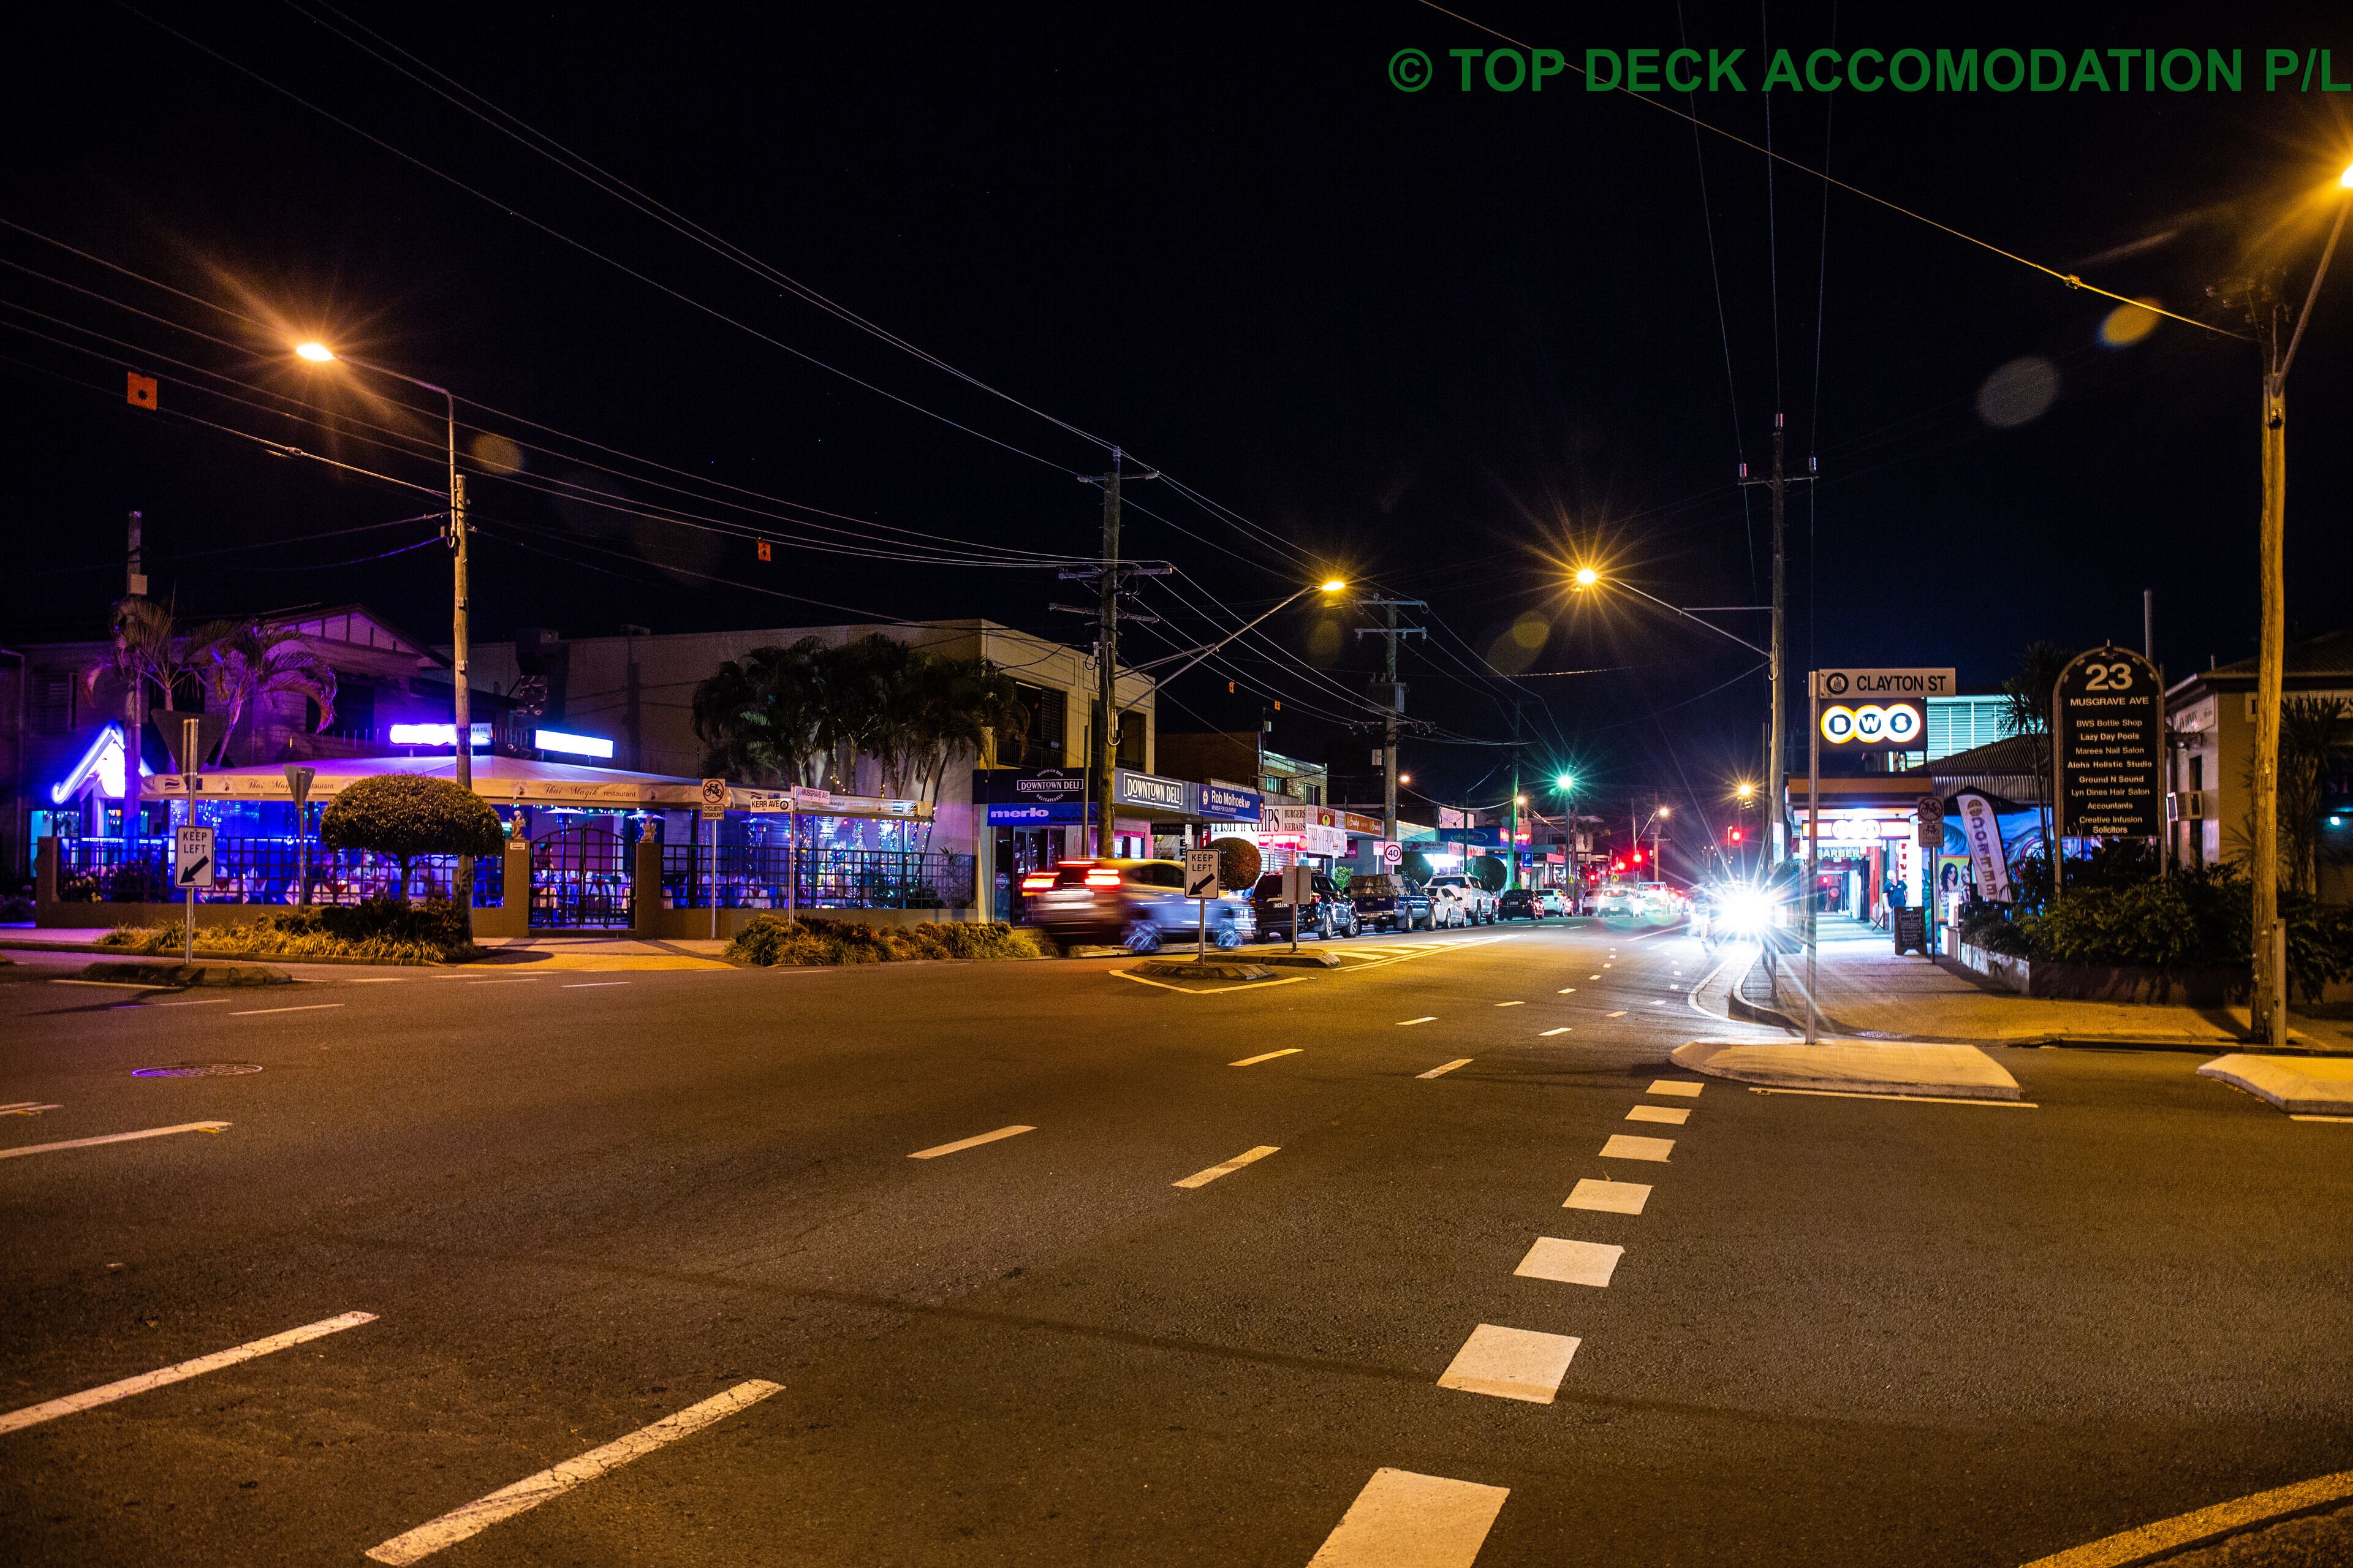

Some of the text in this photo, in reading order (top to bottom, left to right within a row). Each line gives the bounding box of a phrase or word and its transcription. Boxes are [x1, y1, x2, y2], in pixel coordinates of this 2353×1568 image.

[2085, 663, 2133, 691] 23
[1857, 675, 1946, 692] CLAYTON ST
[2070, 695, 2150, 706] MUSGRAVE AVE
[1833, 715, 1908, 733] BWS
[2097, 718, 2120, 727] Bottle
[2122, 718, 2143, 728] Shop
[2080, 732, 2140, 742] Lazy Day Pools
[1036, 769, 1056, 778] SANDWICH
[2078, 775, 2109, 784] Ground
[2118, 775, 2144, 783] Sound
[271, 780, 289, 792] Mag
[544, 784, 563, 795] Thai
[1021, 781, 1080, 790] DOWNTOWN DELI
[801, 788, 822, 798] MUSGRAVE
[1127, 778, 1180, 804] DOWNTOWN DELI
[2071, 788, 2085, 797] Lyn
[1036, 793, 1064, 803] DELICATESSEN
[1211, 790, 1251, 809] Rob Molhoek MP
[990, 808, 1050, 818] merlo
[1284, 809, 1306, 819] BURGERS
[2079, 815, 2143, 824] Creative Infusion
[1284, 823, 1306, 831] KEBABS
[2093, 825, 2128, 834] Solicitors
[183, 831, 207, 841] KEEP
[184, 844, 206, 854] LEFT
[1817, 848, 1860, 858] BARBER
